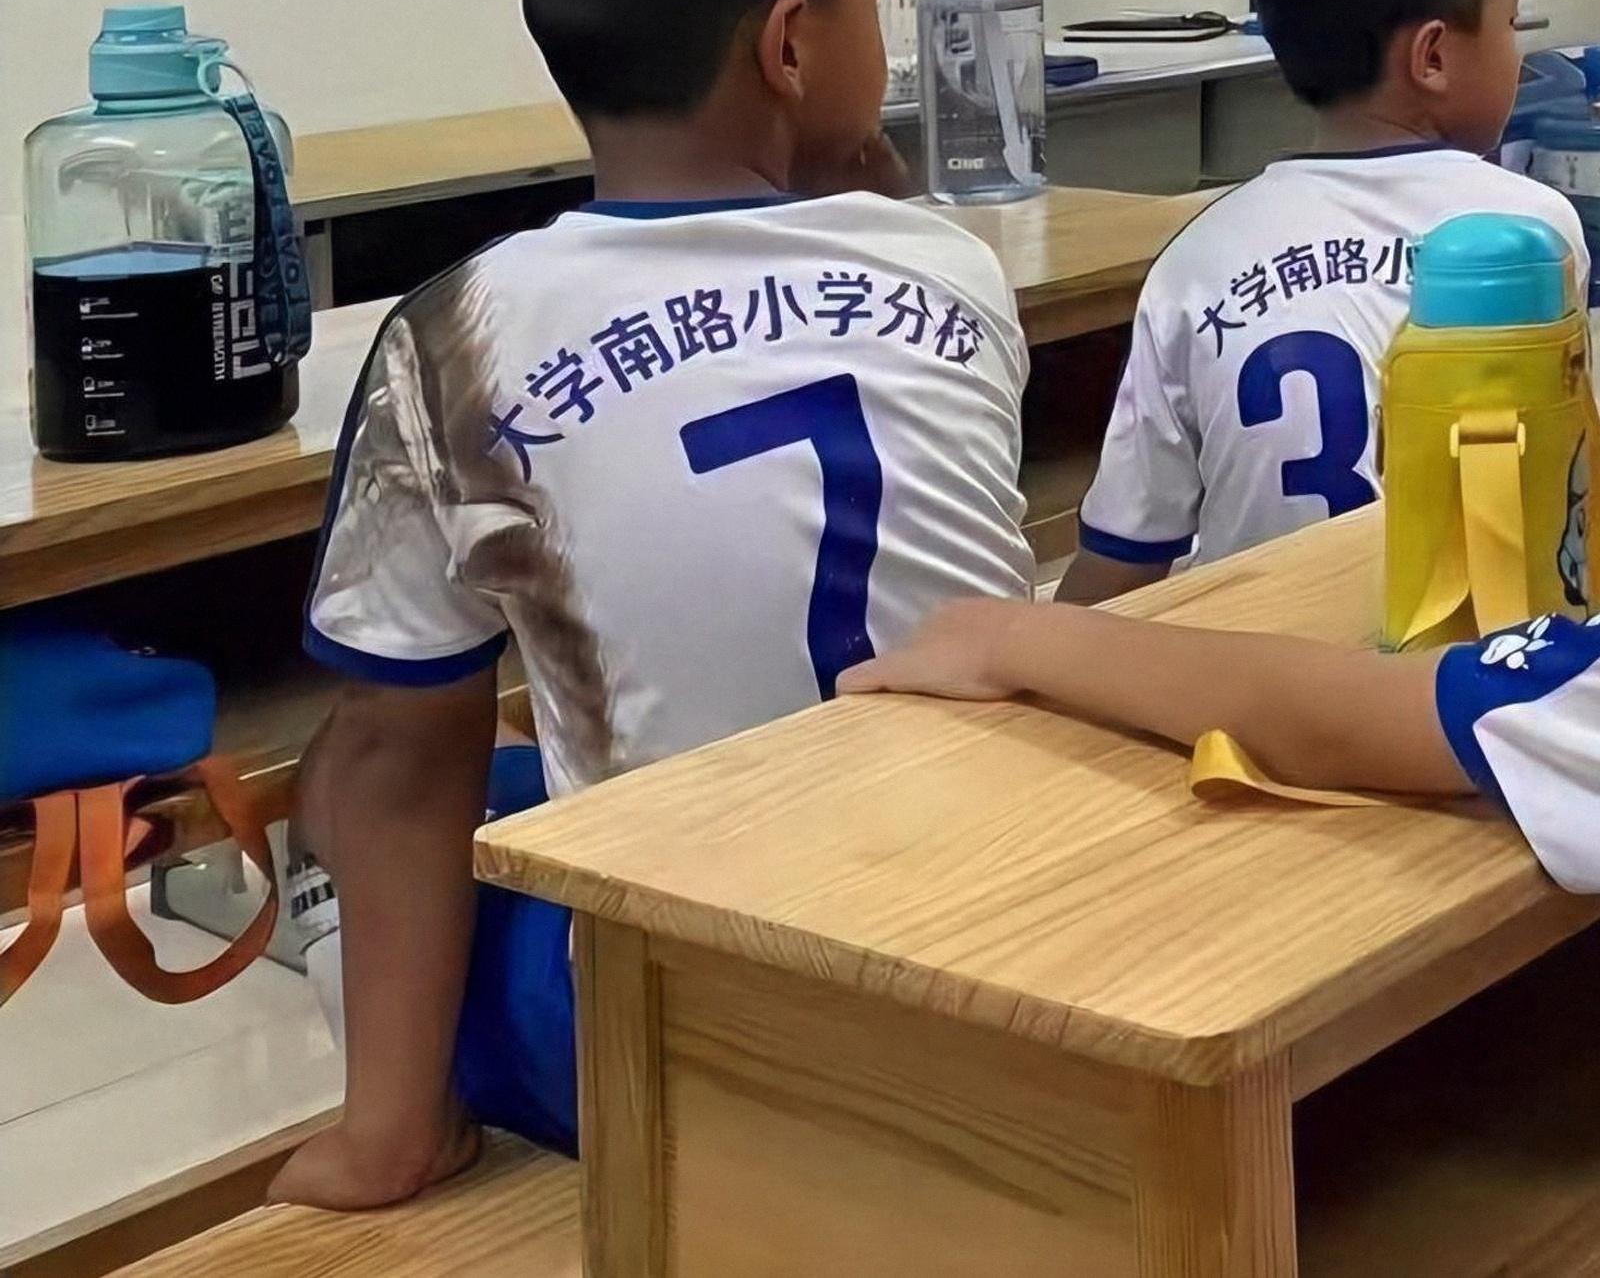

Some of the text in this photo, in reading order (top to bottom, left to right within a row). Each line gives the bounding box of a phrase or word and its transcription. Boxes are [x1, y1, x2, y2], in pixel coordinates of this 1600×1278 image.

[488, 270, 986, 484] 大学南路小学分校
[1236, 330, 1380, 519] 3
[678, 371, 883, 701] 7
